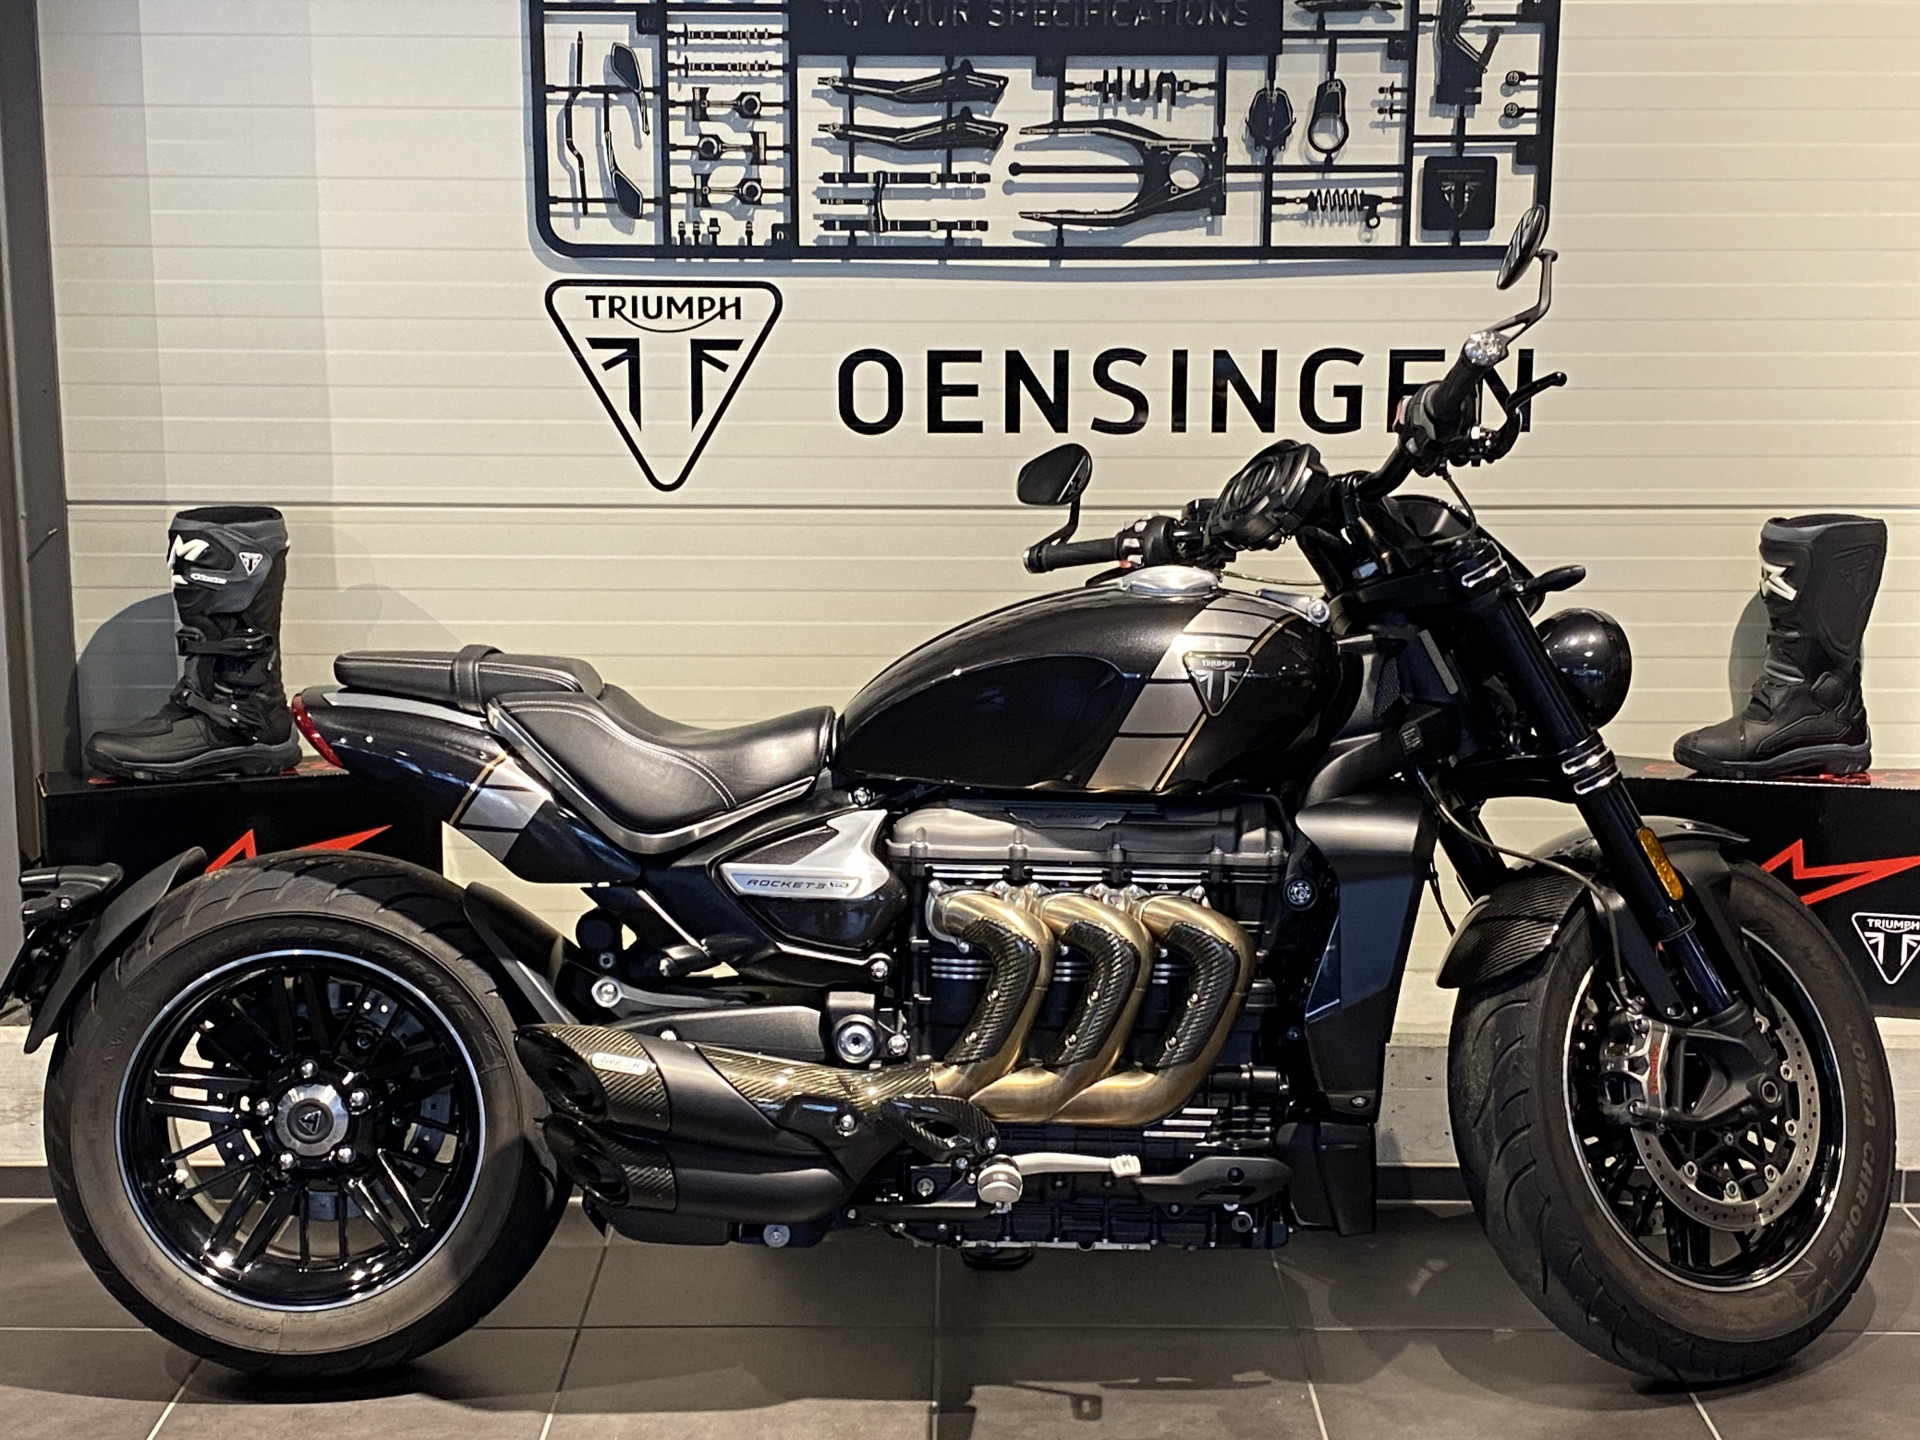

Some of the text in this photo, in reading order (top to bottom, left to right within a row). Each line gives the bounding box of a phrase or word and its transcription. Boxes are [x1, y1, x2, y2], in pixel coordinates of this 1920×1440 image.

[823, 0, 1248, 27] TO YOUR SPECIFICATIONS
[585, 295, 742, 332] TRIUMPH
[1866, 918, 1920, 933] TRIUMPH
[263, 925, 360, 943] COBRA
[372, 942, 475, 1020] CHROME
[1828, 1141, 1876, 1269] CHROME
